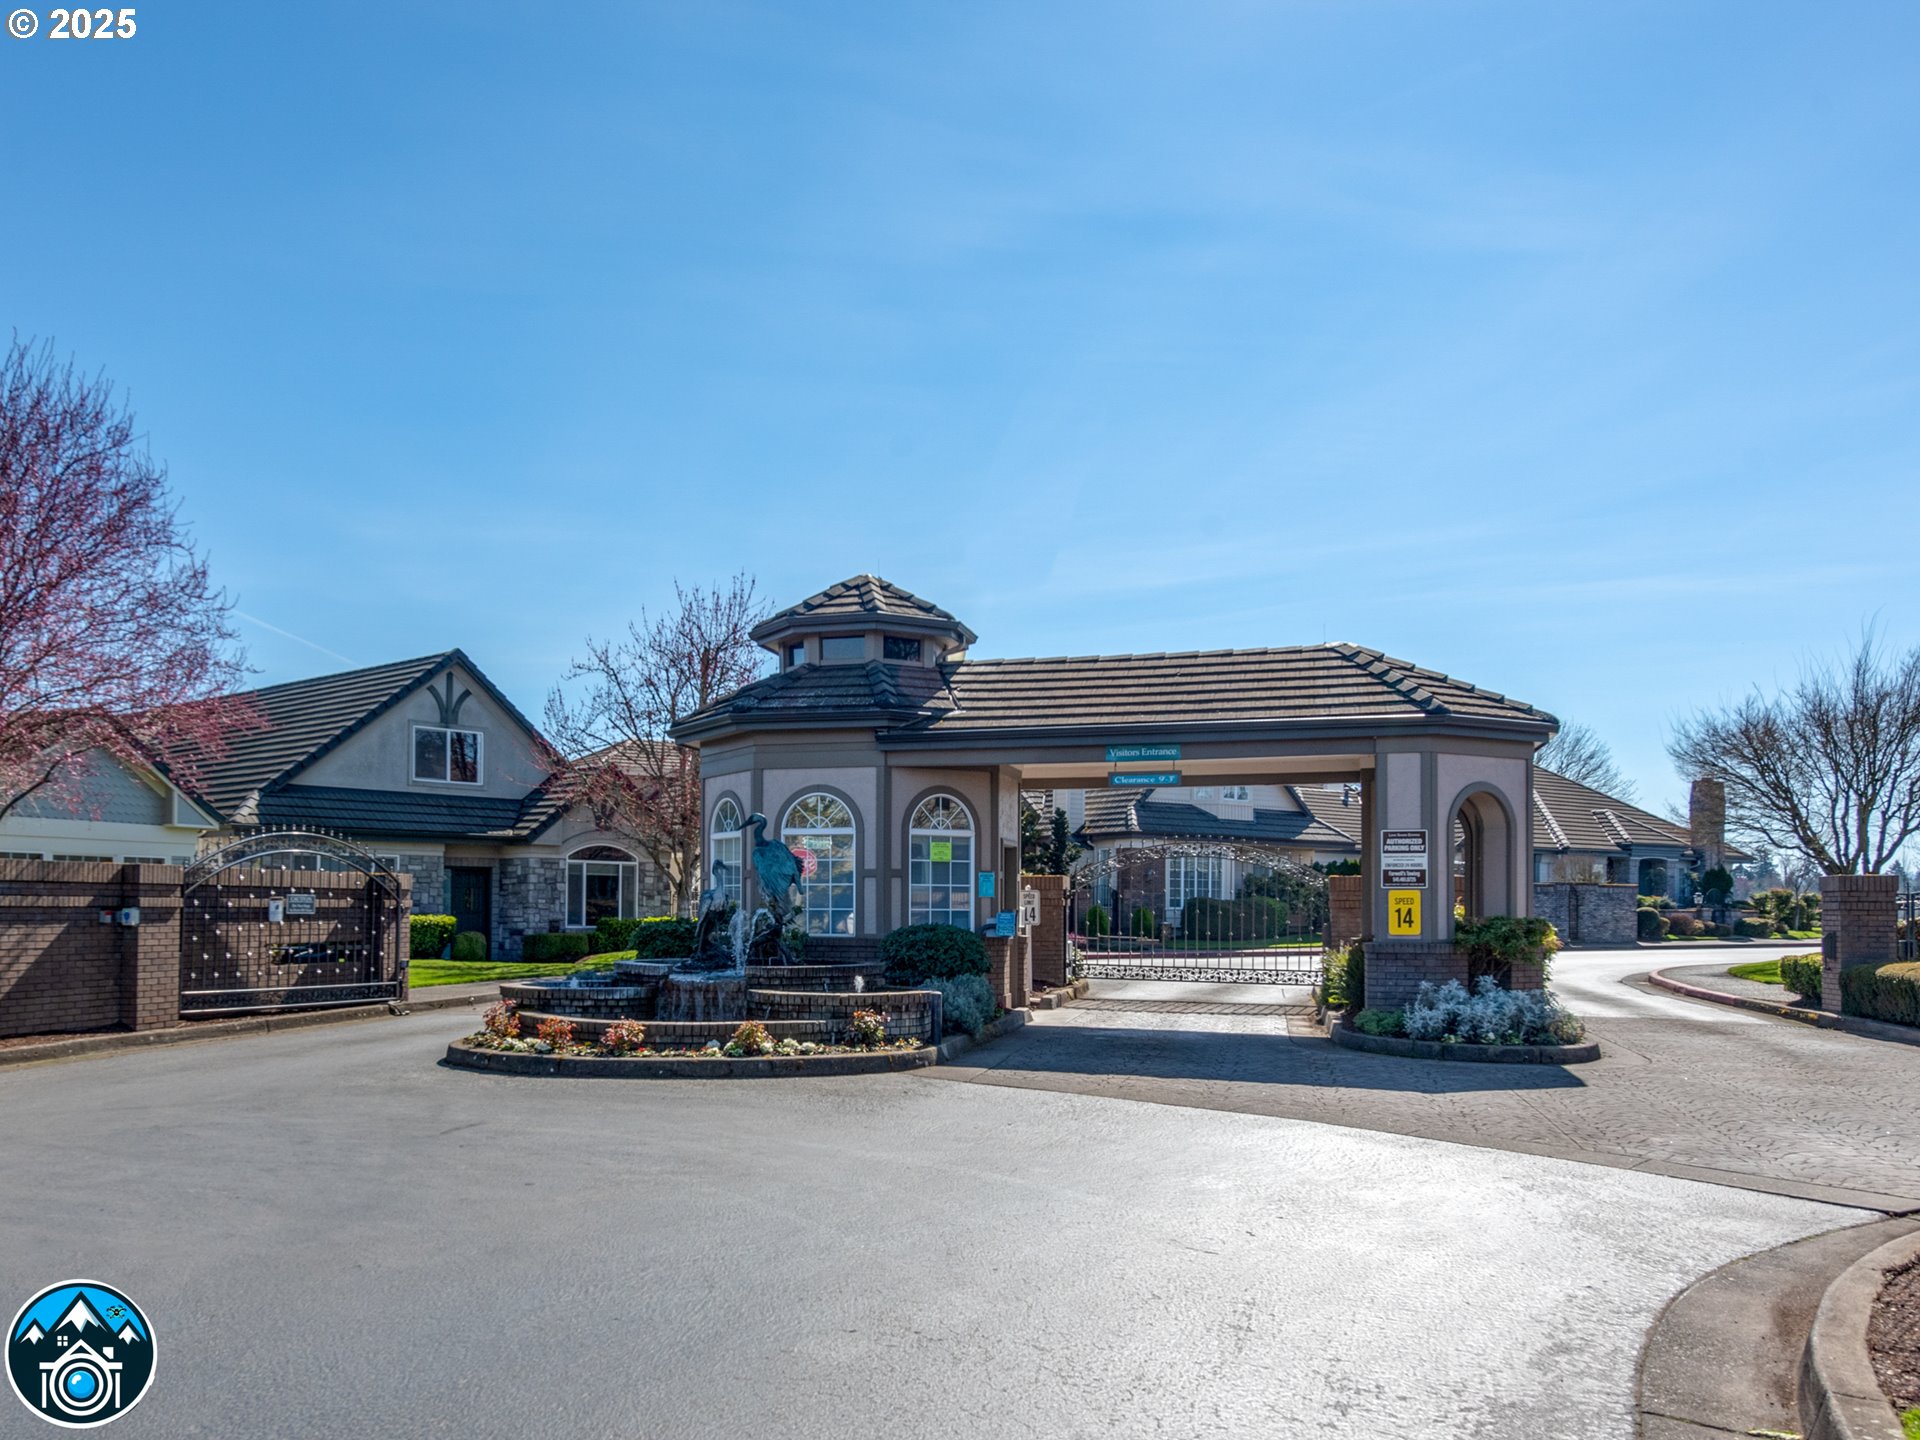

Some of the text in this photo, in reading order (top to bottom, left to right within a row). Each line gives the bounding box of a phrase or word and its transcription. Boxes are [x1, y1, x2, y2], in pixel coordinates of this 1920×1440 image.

[1110, 747, 1177, 757] Visitors Entrance
[1114, 775, 1155, 784] Clearance
[1394, 897, 1415, 905] SPEED
[1395, 907, 1414, 928] 14
